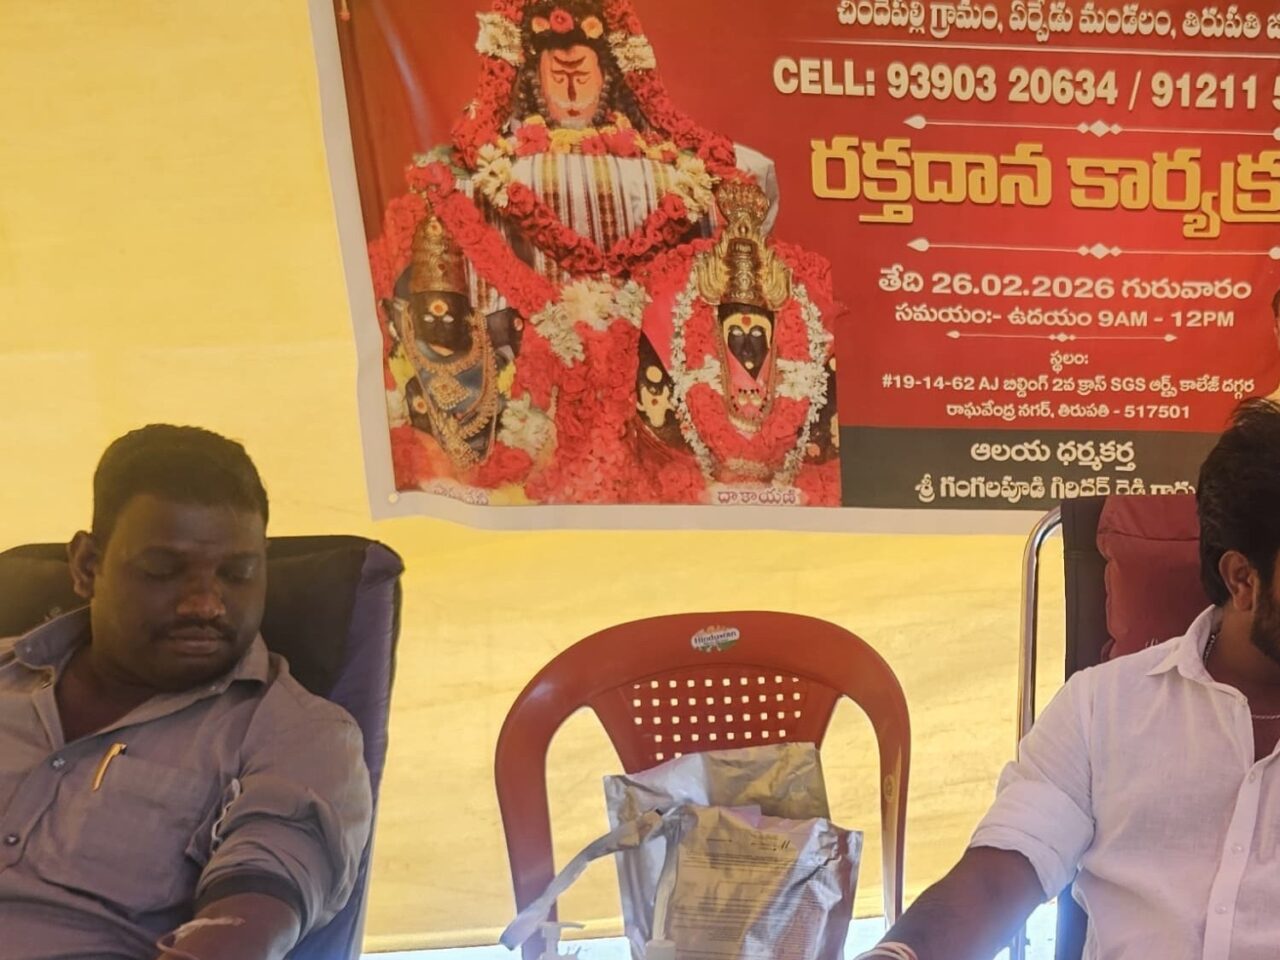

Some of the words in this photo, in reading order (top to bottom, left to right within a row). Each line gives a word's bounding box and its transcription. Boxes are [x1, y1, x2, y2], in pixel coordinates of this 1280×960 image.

[1079, 1, 1177, 39] మండలం,
[1182, 5, 1261, 39] తిరుపతి
[773, 57, 876, 96] CELL:
[887, 62, 997, 101] 93903
[1008, 66, 1119, 105] 20634
[1128, 69, 1142, 111] /
[1150, 71, 1257, 109] 91211
[810, 136, 1052, 224] రక్తదాన
[878, 263, 924, 293] తేది
[931, 272, 1115, 299] 26.02.2026
[1121, 277, 1252, 300] గురువారం
[1007, 306, 1093, 326] ఉదయం
[1098, 310, 1148, 327] 9AM
[1170, 311, 1235, 327] 12PM
[1049, 350, 1090, 374] స్థలం:
[882, 374, 975, 391] #19-14-62
[979, 377, 999, 391] AJ
[1003, 375, 1049, 398] బిల్డింగ్
[1077, 375, 1107, 396] క్రాస్
[1110, 377, 1146, 392] SGS
[1222, 378, 1255, 400] దగ్గర
[946, 400, 1016, 421] రాఘవేంద్ర
[1057, 403, 1110, 418] తిరుపతి
[1124, 405, 1190, 419] 517501
[970, 439, 1050, 462] ఆలయ
[1056, 440, 1136, 472] ధర్మకర్త
[914, 473, 936, 504] శ్రీ
[939, 475, 1046, 504] గంగలపూడి
